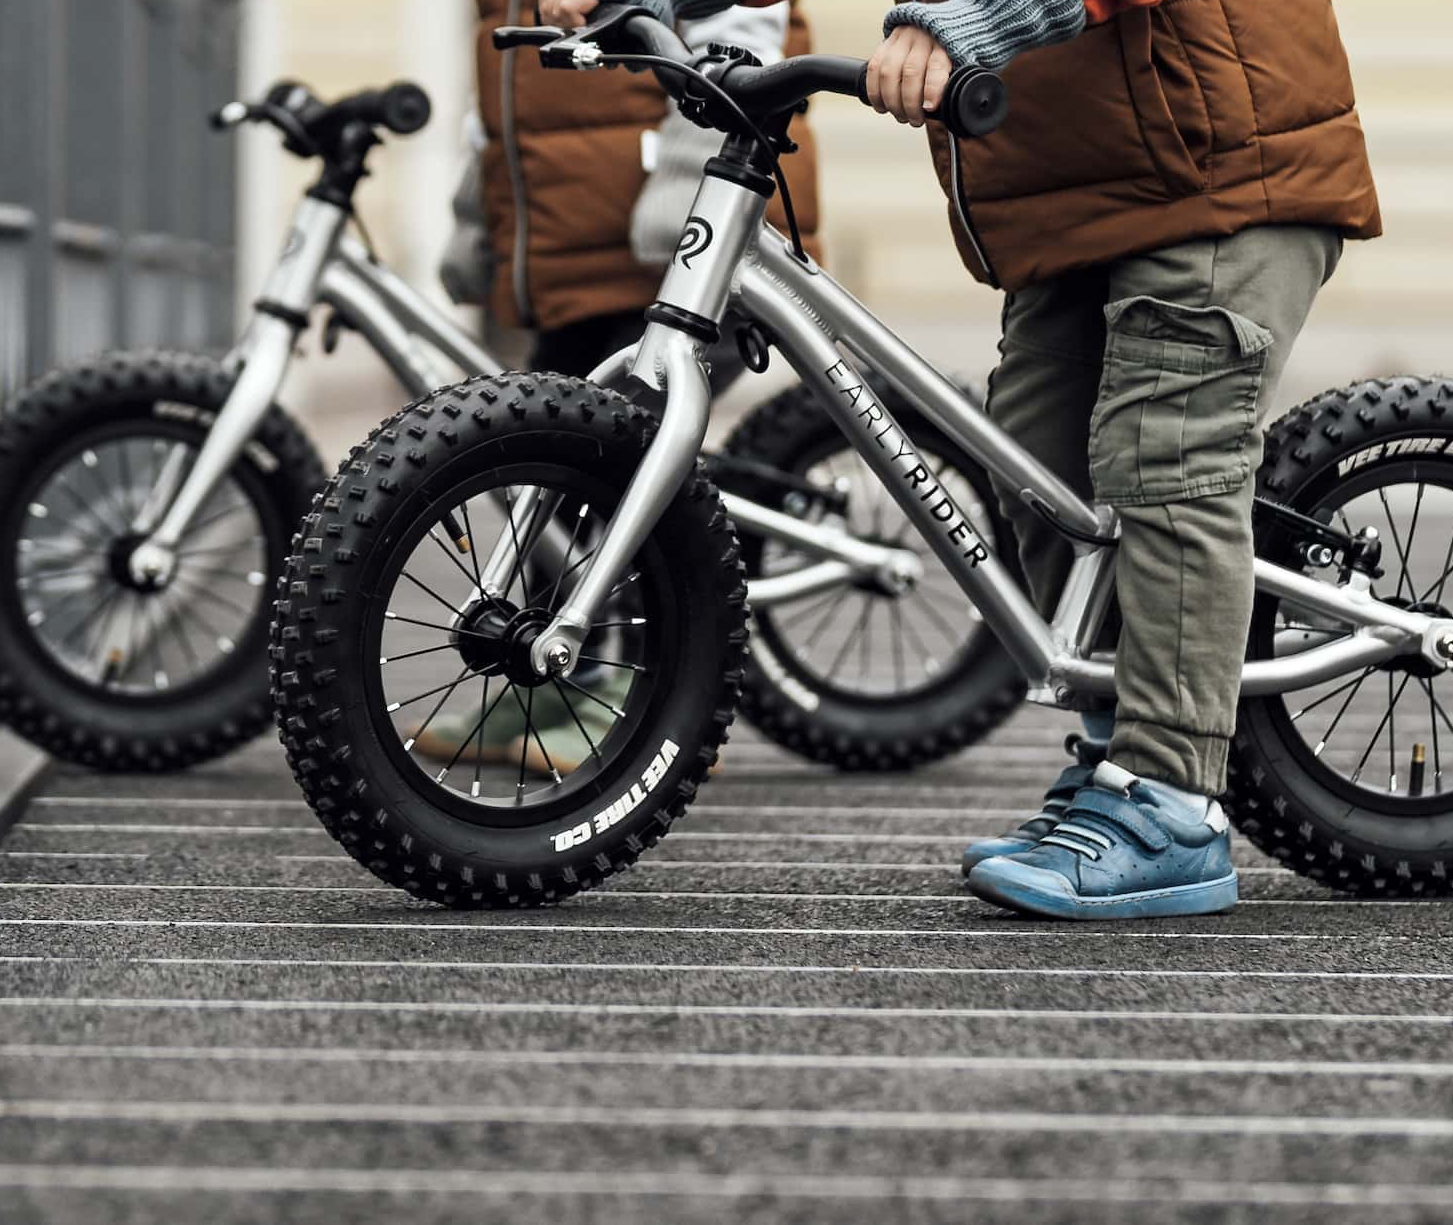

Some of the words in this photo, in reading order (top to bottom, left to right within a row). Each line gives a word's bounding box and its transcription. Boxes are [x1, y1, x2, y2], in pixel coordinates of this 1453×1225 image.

[1336, 443, 1384, 478] VEE
[1385, 438, 1446, 458] TIRE
[641, 739, 680, 792] VEE
[594, 783, 648, 834] TIRE
